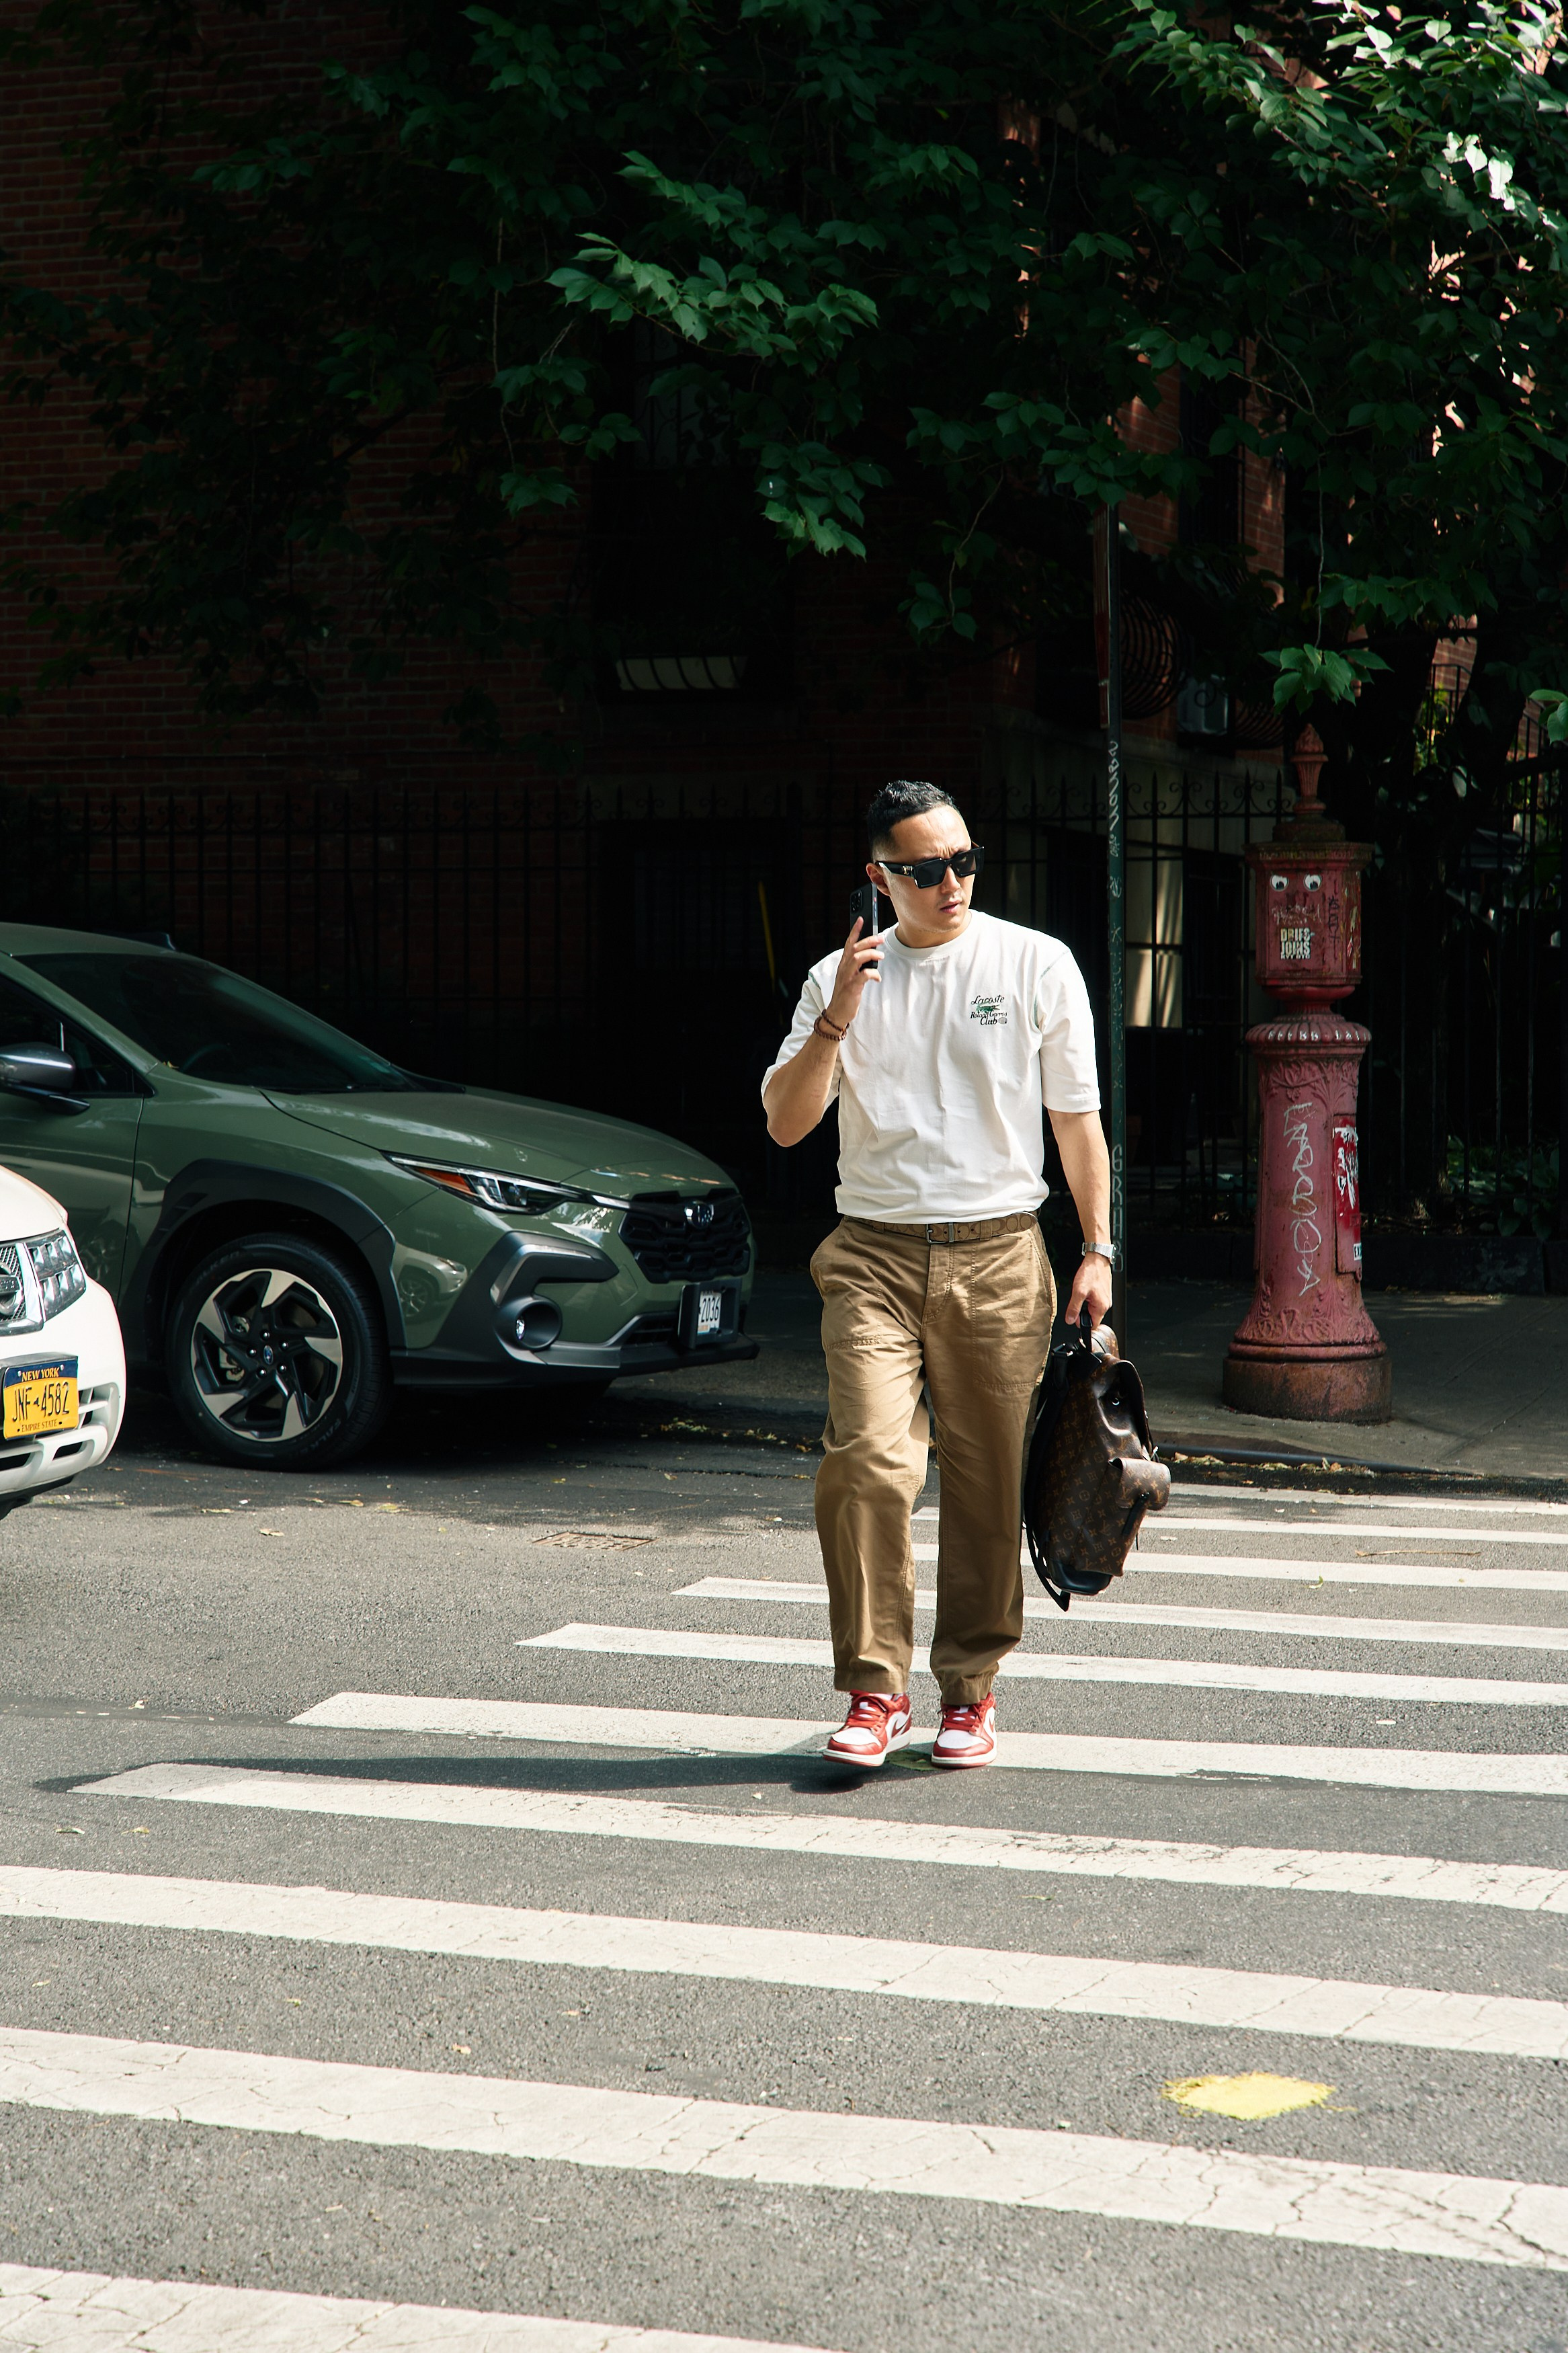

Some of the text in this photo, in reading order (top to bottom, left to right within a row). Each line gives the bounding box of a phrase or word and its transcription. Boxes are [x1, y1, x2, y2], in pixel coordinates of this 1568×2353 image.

[971, 994, 1005, 1005] Lacoste
[980, 1017, 998, 1026] Club
[701, 1297, 720, 1322] 2036
[22, 1367, 60, 1382] NEW YORK
[40, 1382, 70, 1417] 4582
[22, 1419, 57, 1432] EMPIRE STATE
